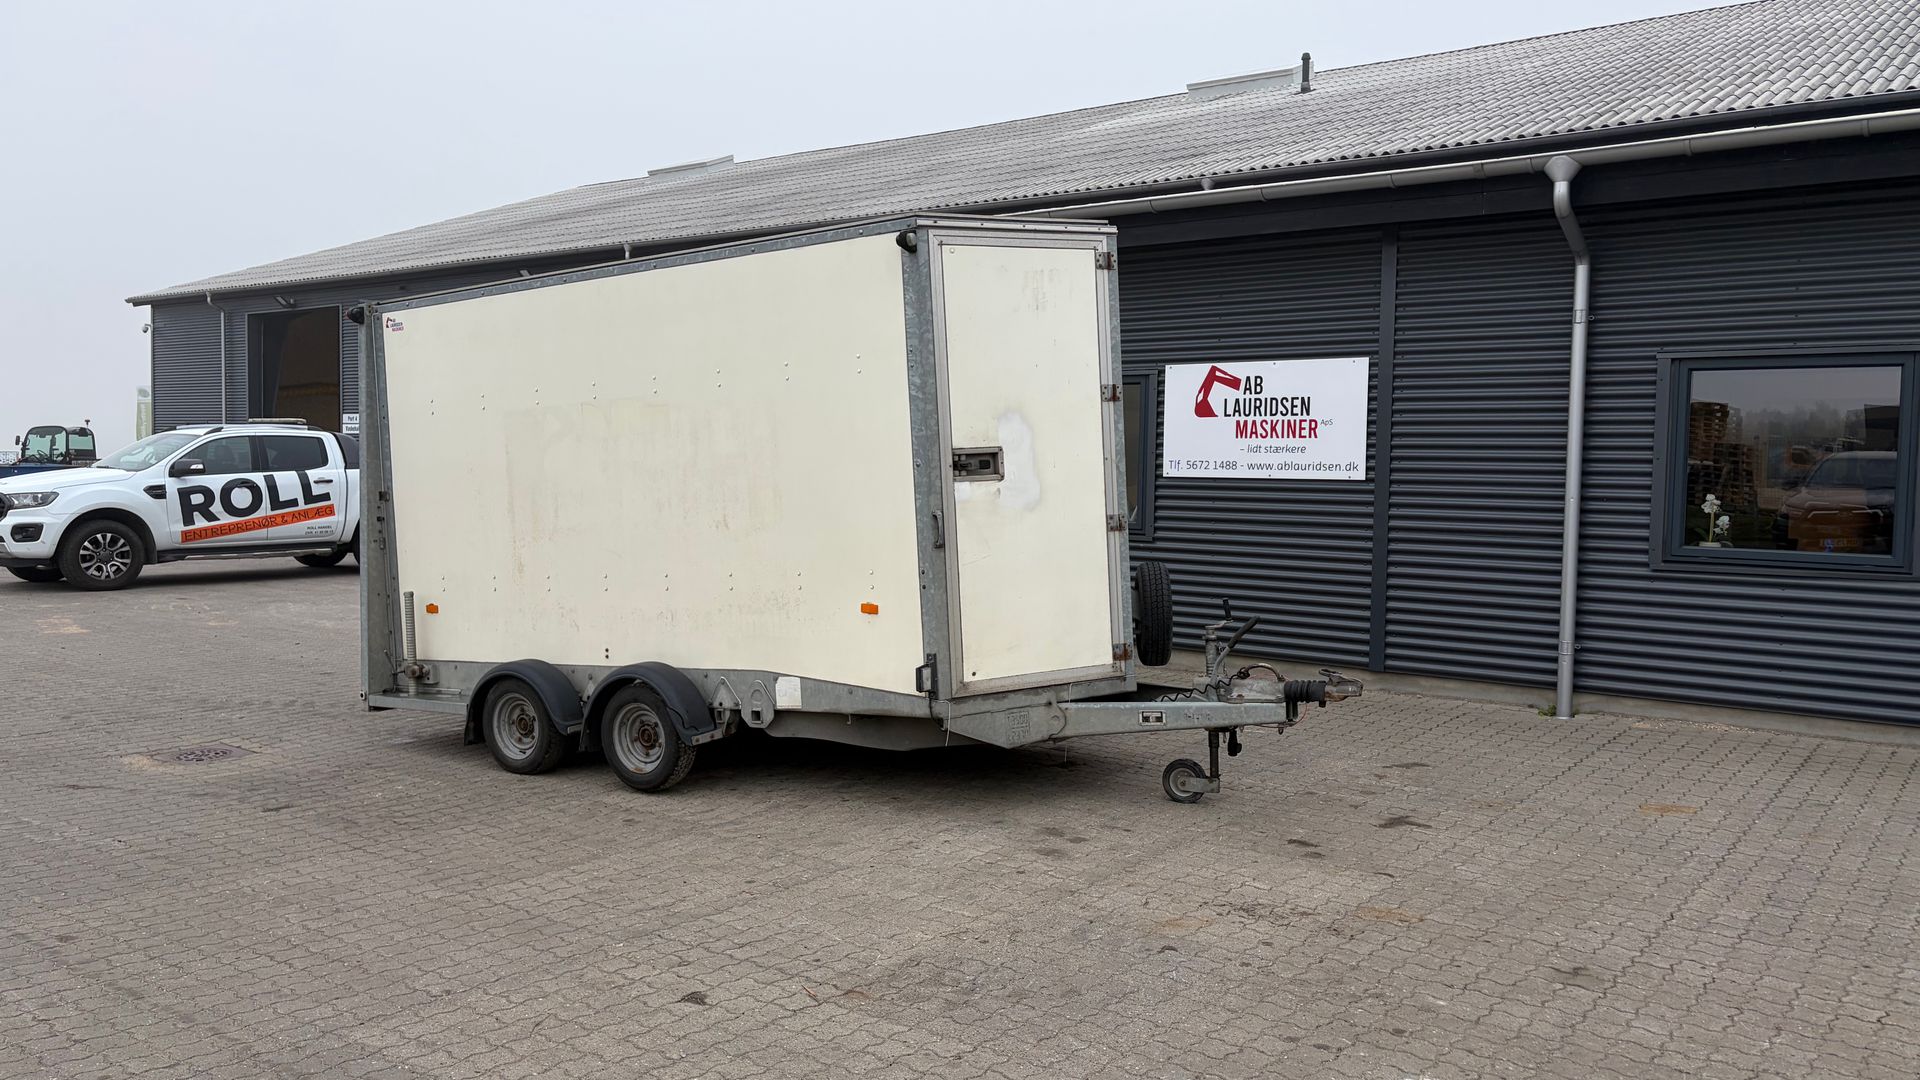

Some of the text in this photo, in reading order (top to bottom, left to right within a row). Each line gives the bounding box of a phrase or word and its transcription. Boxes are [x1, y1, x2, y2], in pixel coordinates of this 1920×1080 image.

[1243, 375, 1264, 395] AB
[1223, 396, 1311, 418] LAURIDSEN
[1235, 418, 1334, 439] MASKINER ApS
[1247, 444, 1262, 454] lidt
[1264, 444, 1307, 454] stærkere
[1169, 460, 1183, 471] Tlf.
[1186, 460, 1210, 470] 5672
[1213, 460, 1238, 470] 1488
[1247, 461, 1359, 472] www.ablauridsen.dk
[177, 470, 331, 527] ROLL
[184, 506, 333, 542] ENTREPRENØR & ANLÆG
